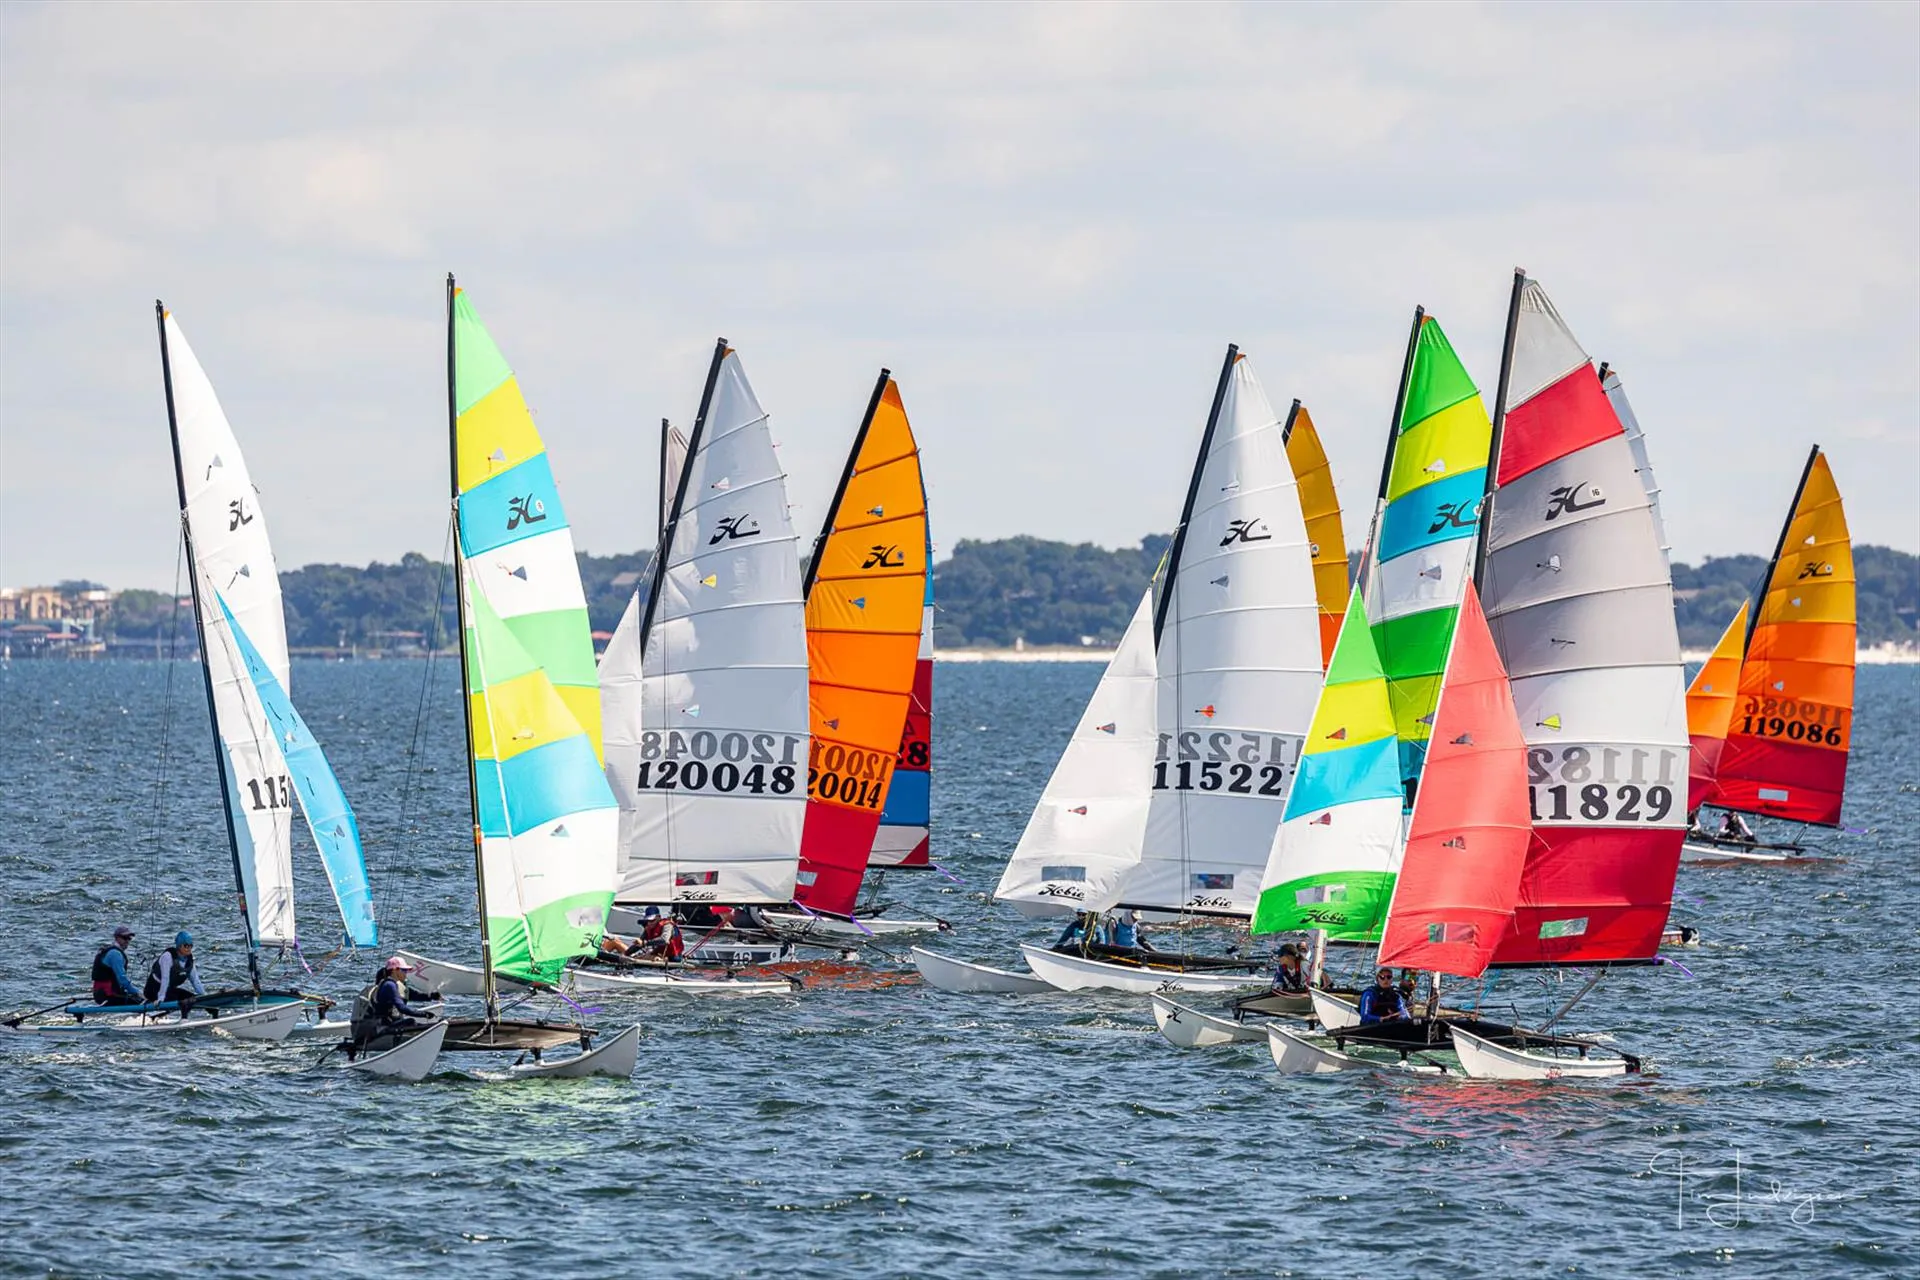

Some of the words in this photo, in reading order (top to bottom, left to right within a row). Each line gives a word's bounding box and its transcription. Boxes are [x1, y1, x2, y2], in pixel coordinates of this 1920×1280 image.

[1741, 715, 1842, 746] 119086
[637, 760, 795, 794] 120048
[1152, 761, 1295, 796] 11522
[247, 775, 290, 810] 115
[672, 889, 717, 902] Hobie
[1037, 884, 1085, 901] Hobie
[1186, 895, 1232, 909] Hobie
[1299, 909, 1347, 926] Hobie
